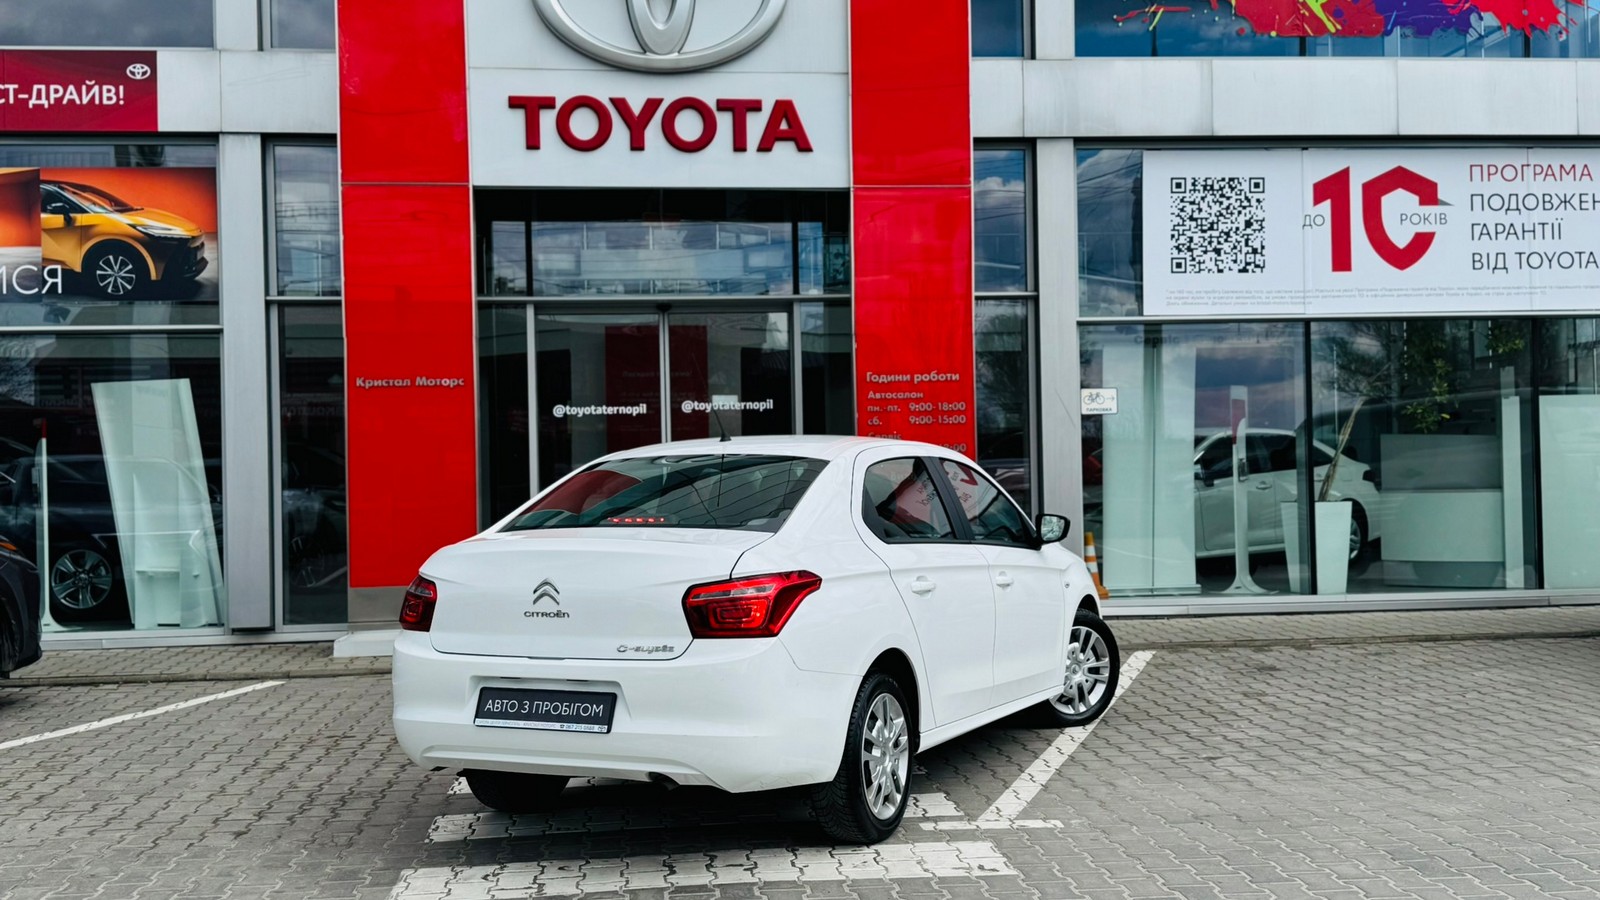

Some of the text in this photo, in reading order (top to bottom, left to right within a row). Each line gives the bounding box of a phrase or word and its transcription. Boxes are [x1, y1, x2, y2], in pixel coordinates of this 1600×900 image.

[508, 95, 813, 153] TOYOTA
[1470, 164, 1593, 182] ПРОГРАМА
[1302, 214, 1326, 230] ДО
[1400, 213, 1448, 226] РОКІВ
[1471, 217, 1564, 241] ГАРАНТІЇ
[1472, 251, 1599, 274] ВІД TOYOTA
[356, 376, 465, 389] Кристал Моторс
[866, 370, 960, 384] Години роботи
[868, 390, 923, 399] Автосалон
[552, 403, 647, 417] @toyotaternopil
[681, 398, 774, 414] @toyotaternopil
[868, 416, 883, 425] сб.
[523, 609, 570, 619] CITROËN
[484, 699, 519, 713] АВТО
[532, 701, 604, 717] ПРОБІГОМ
